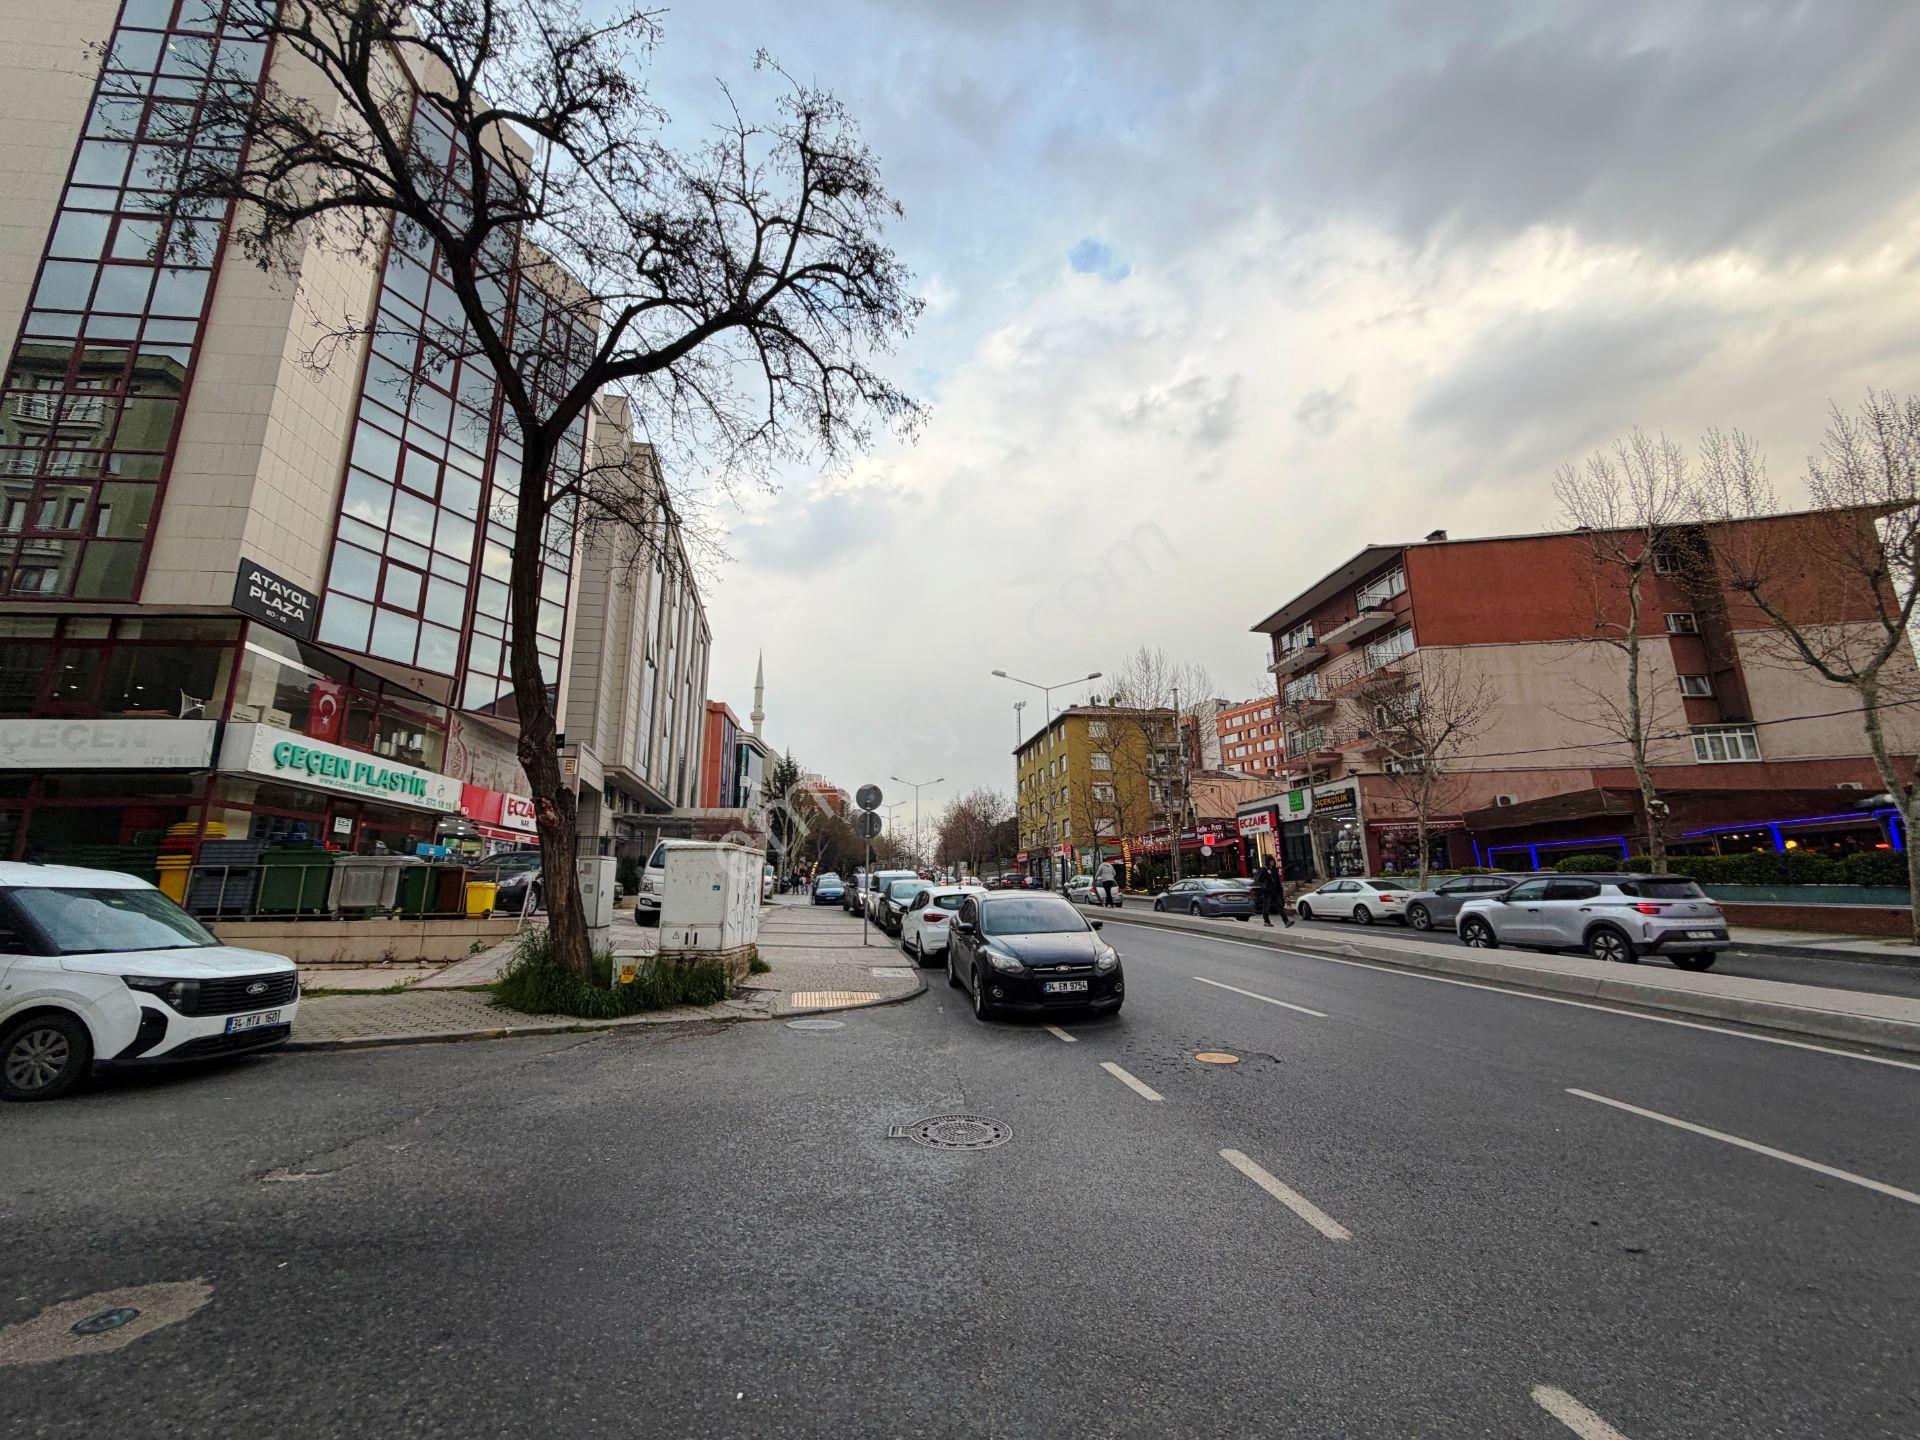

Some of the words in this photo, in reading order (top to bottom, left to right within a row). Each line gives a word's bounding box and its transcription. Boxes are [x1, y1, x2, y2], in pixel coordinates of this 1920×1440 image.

[249, 571, 310, 609] ATAYOL
[249, 585, 304, 621] PLAZA
[273, 742, 351, 779] ÇEÇEN
[354, 762, 428, 797] PLASTİK
[507, 797, 536, 819] ECZA
[1240, 815, 1268, 829] ECZANE
[1046, 983, 1056, 991] 34
[1069, 981, 1087, 990] 9754
[233, 1018, 242, 1030] 34
